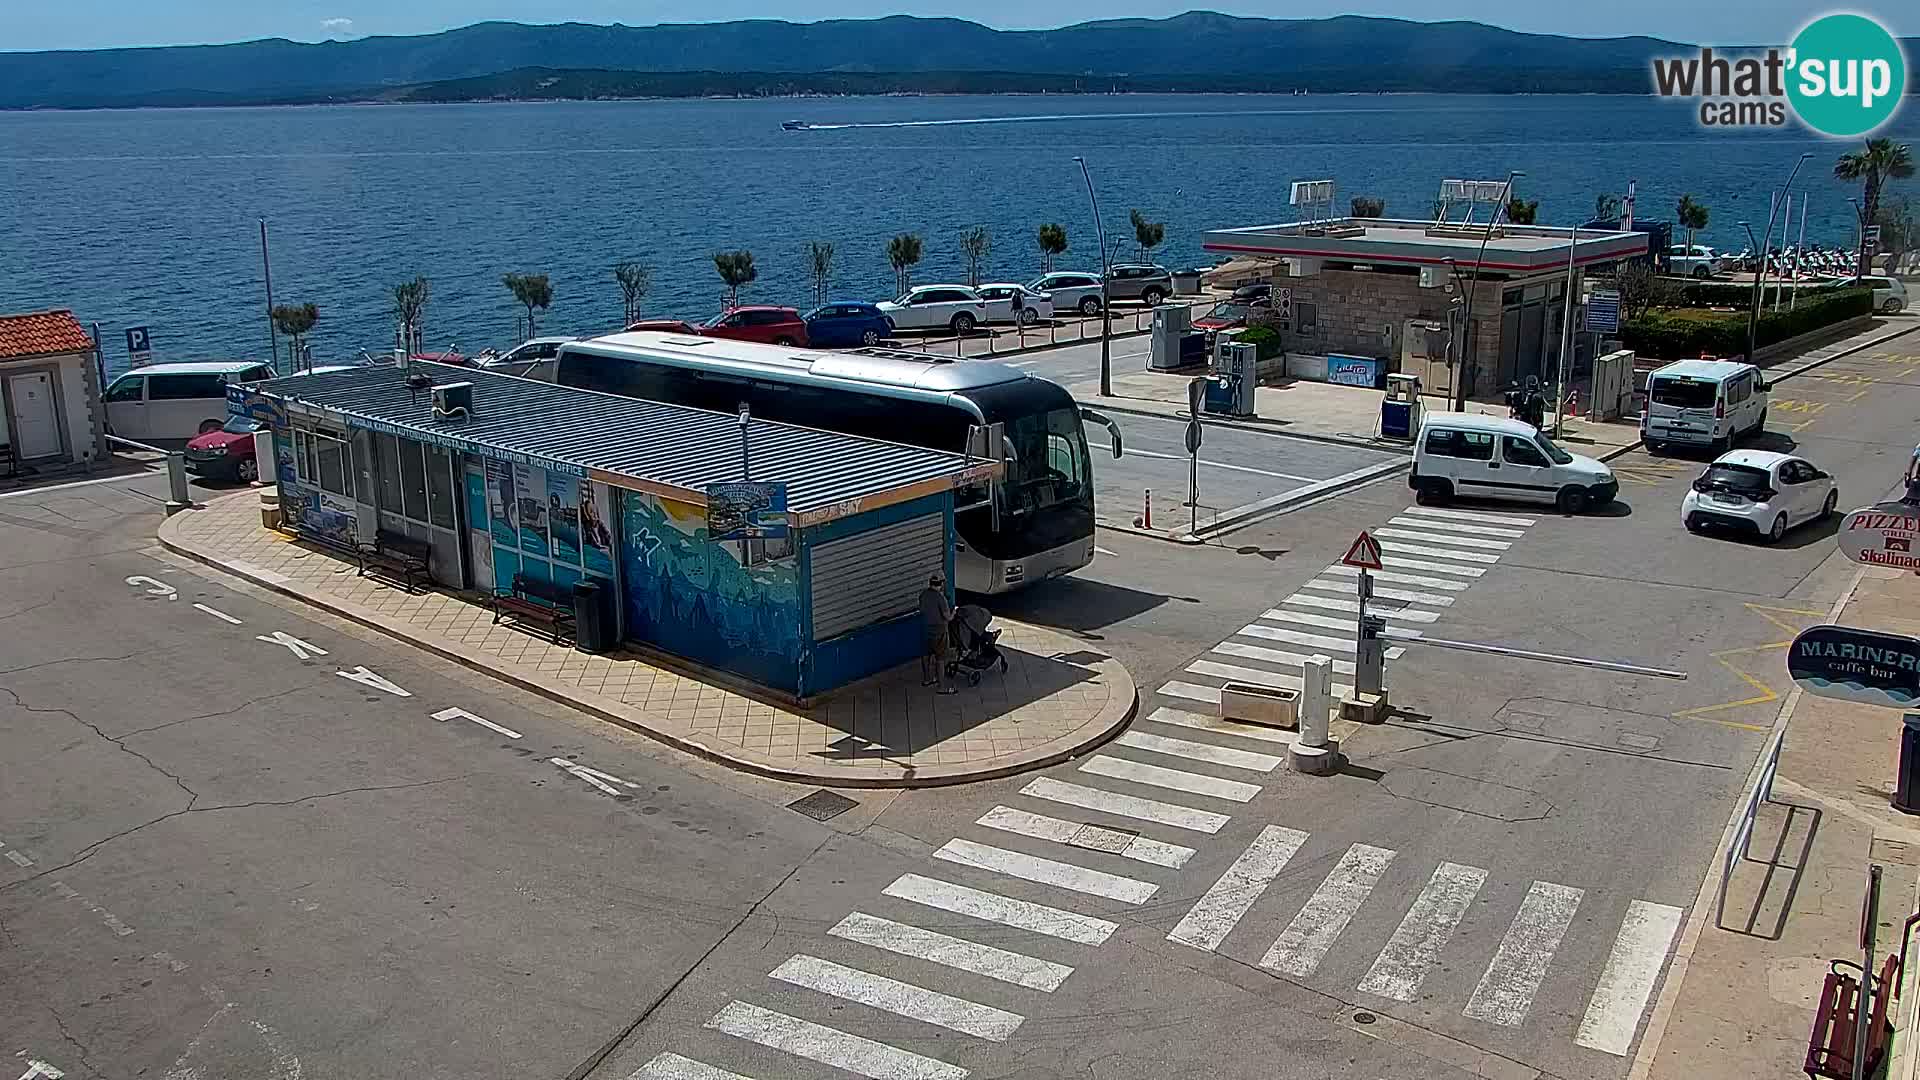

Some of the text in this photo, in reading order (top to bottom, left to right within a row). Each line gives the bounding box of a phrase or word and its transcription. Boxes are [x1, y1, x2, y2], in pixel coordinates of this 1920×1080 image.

[131, 330, 143, 348] P
[437, 434, 468, 450] POSTAJA
[479, 446, 494, 457] BUS
[495, 448, 527, 464] STATION
[529, 456, 555, 471] TICKET
[556, 461, 583, 476] OFFICE
[1848, 514, 1920, 532] PIZZE
[1828, 661, 1897, 679] caffe bar
